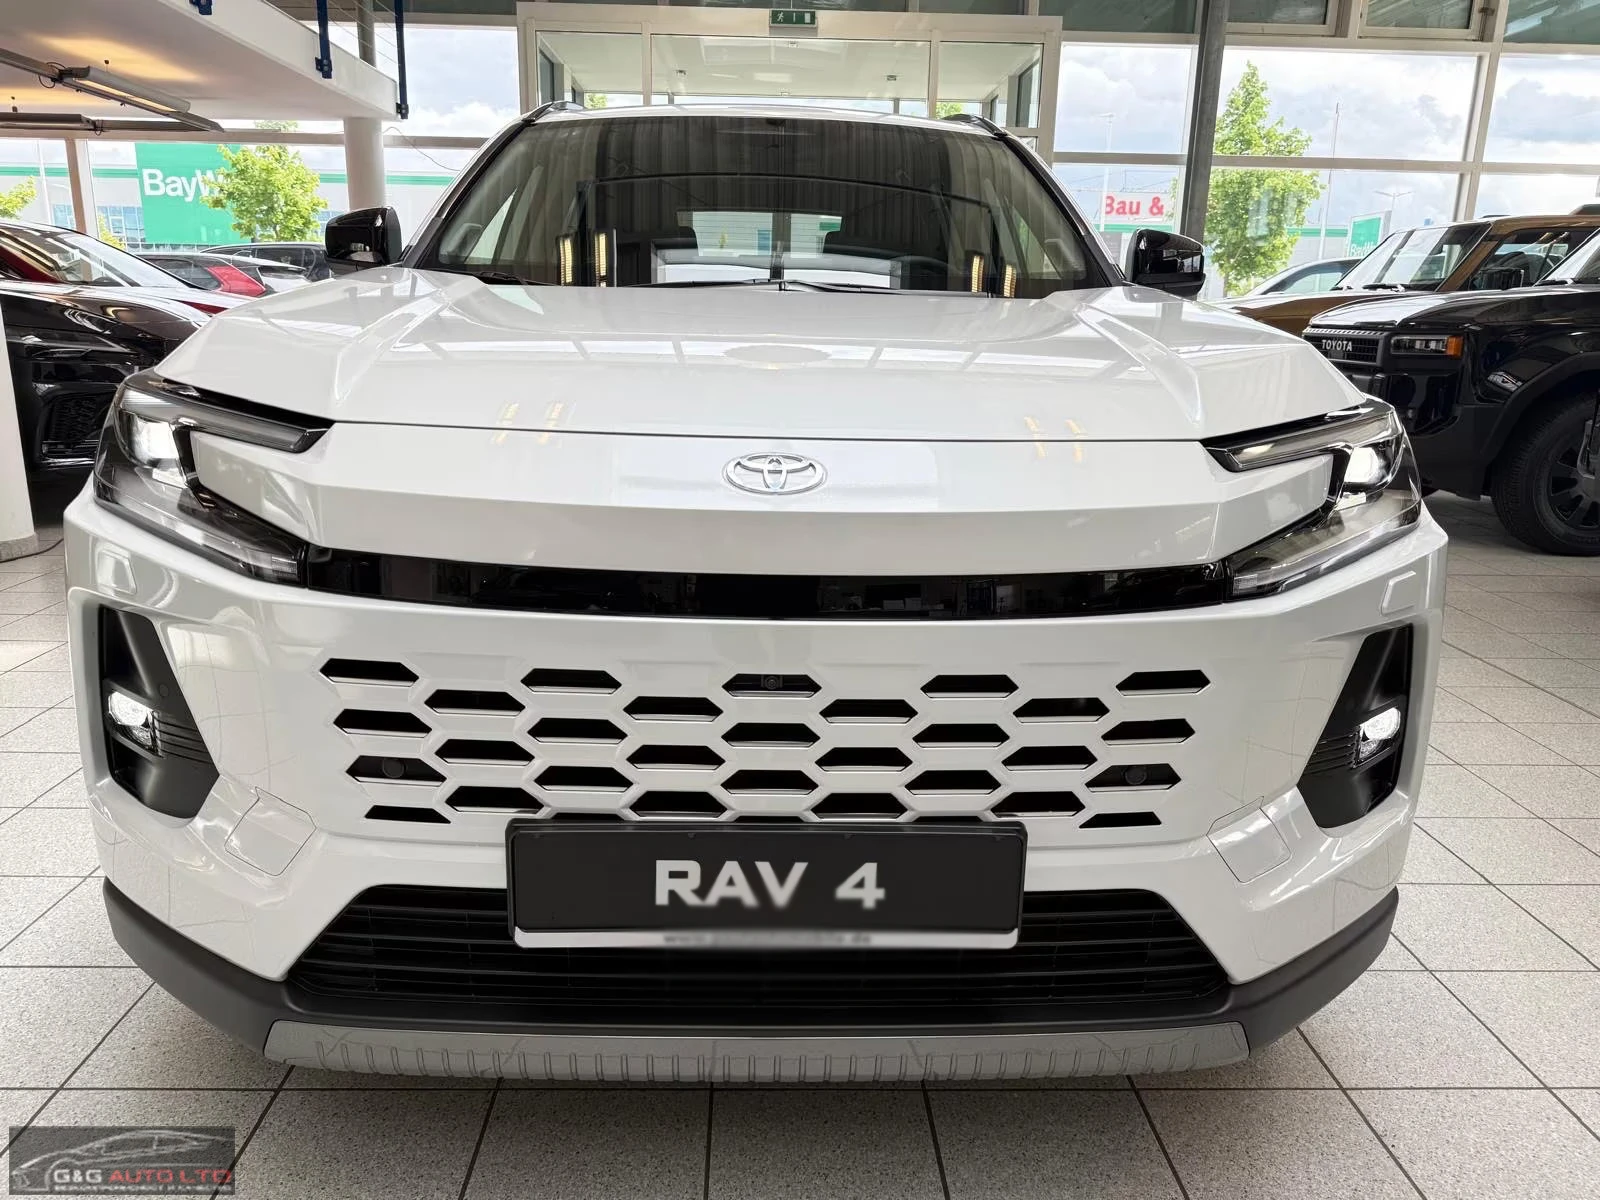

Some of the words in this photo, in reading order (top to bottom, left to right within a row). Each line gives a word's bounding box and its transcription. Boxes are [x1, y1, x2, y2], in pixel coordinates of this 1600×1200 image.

[141, 168, 225, 202] BayW
[1105, 195, 1141, 215] Bau
[1149, 196, 1164, 216] &
[1321, 339, 1352, 351] TOYOTA
[655, 859, 808, 908] RAV
[835, 862, 885, 910] 4
